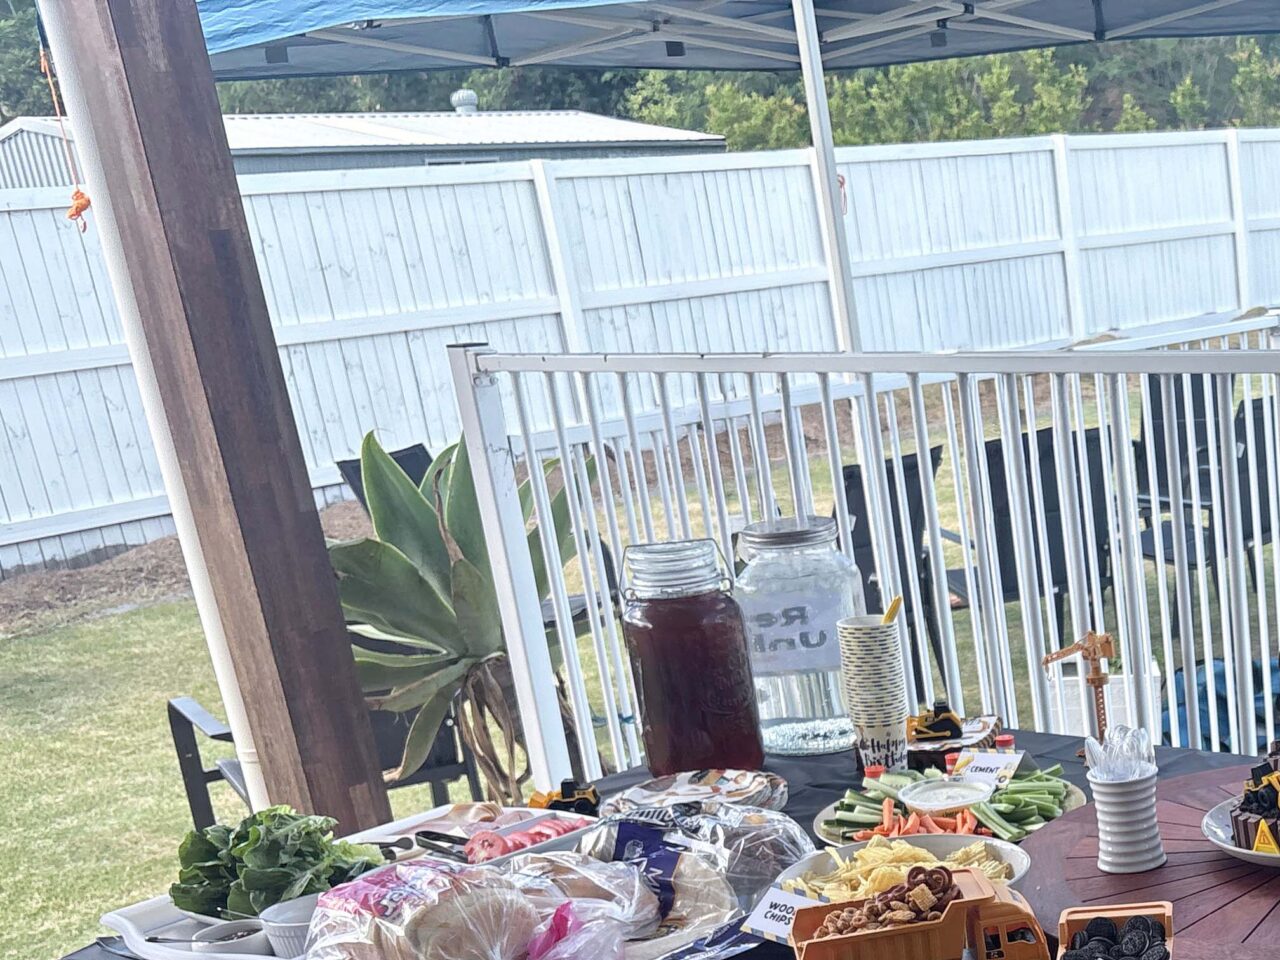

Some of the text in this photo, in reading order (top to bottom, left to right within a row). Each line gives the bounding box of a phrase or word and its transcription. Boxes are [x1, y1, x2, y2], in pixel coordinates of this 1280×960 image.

[970, 765, 1001, 773] CEMENT
[768, 901, 797, 916] WOO
[764, 911, 793, 925] CHIPS
